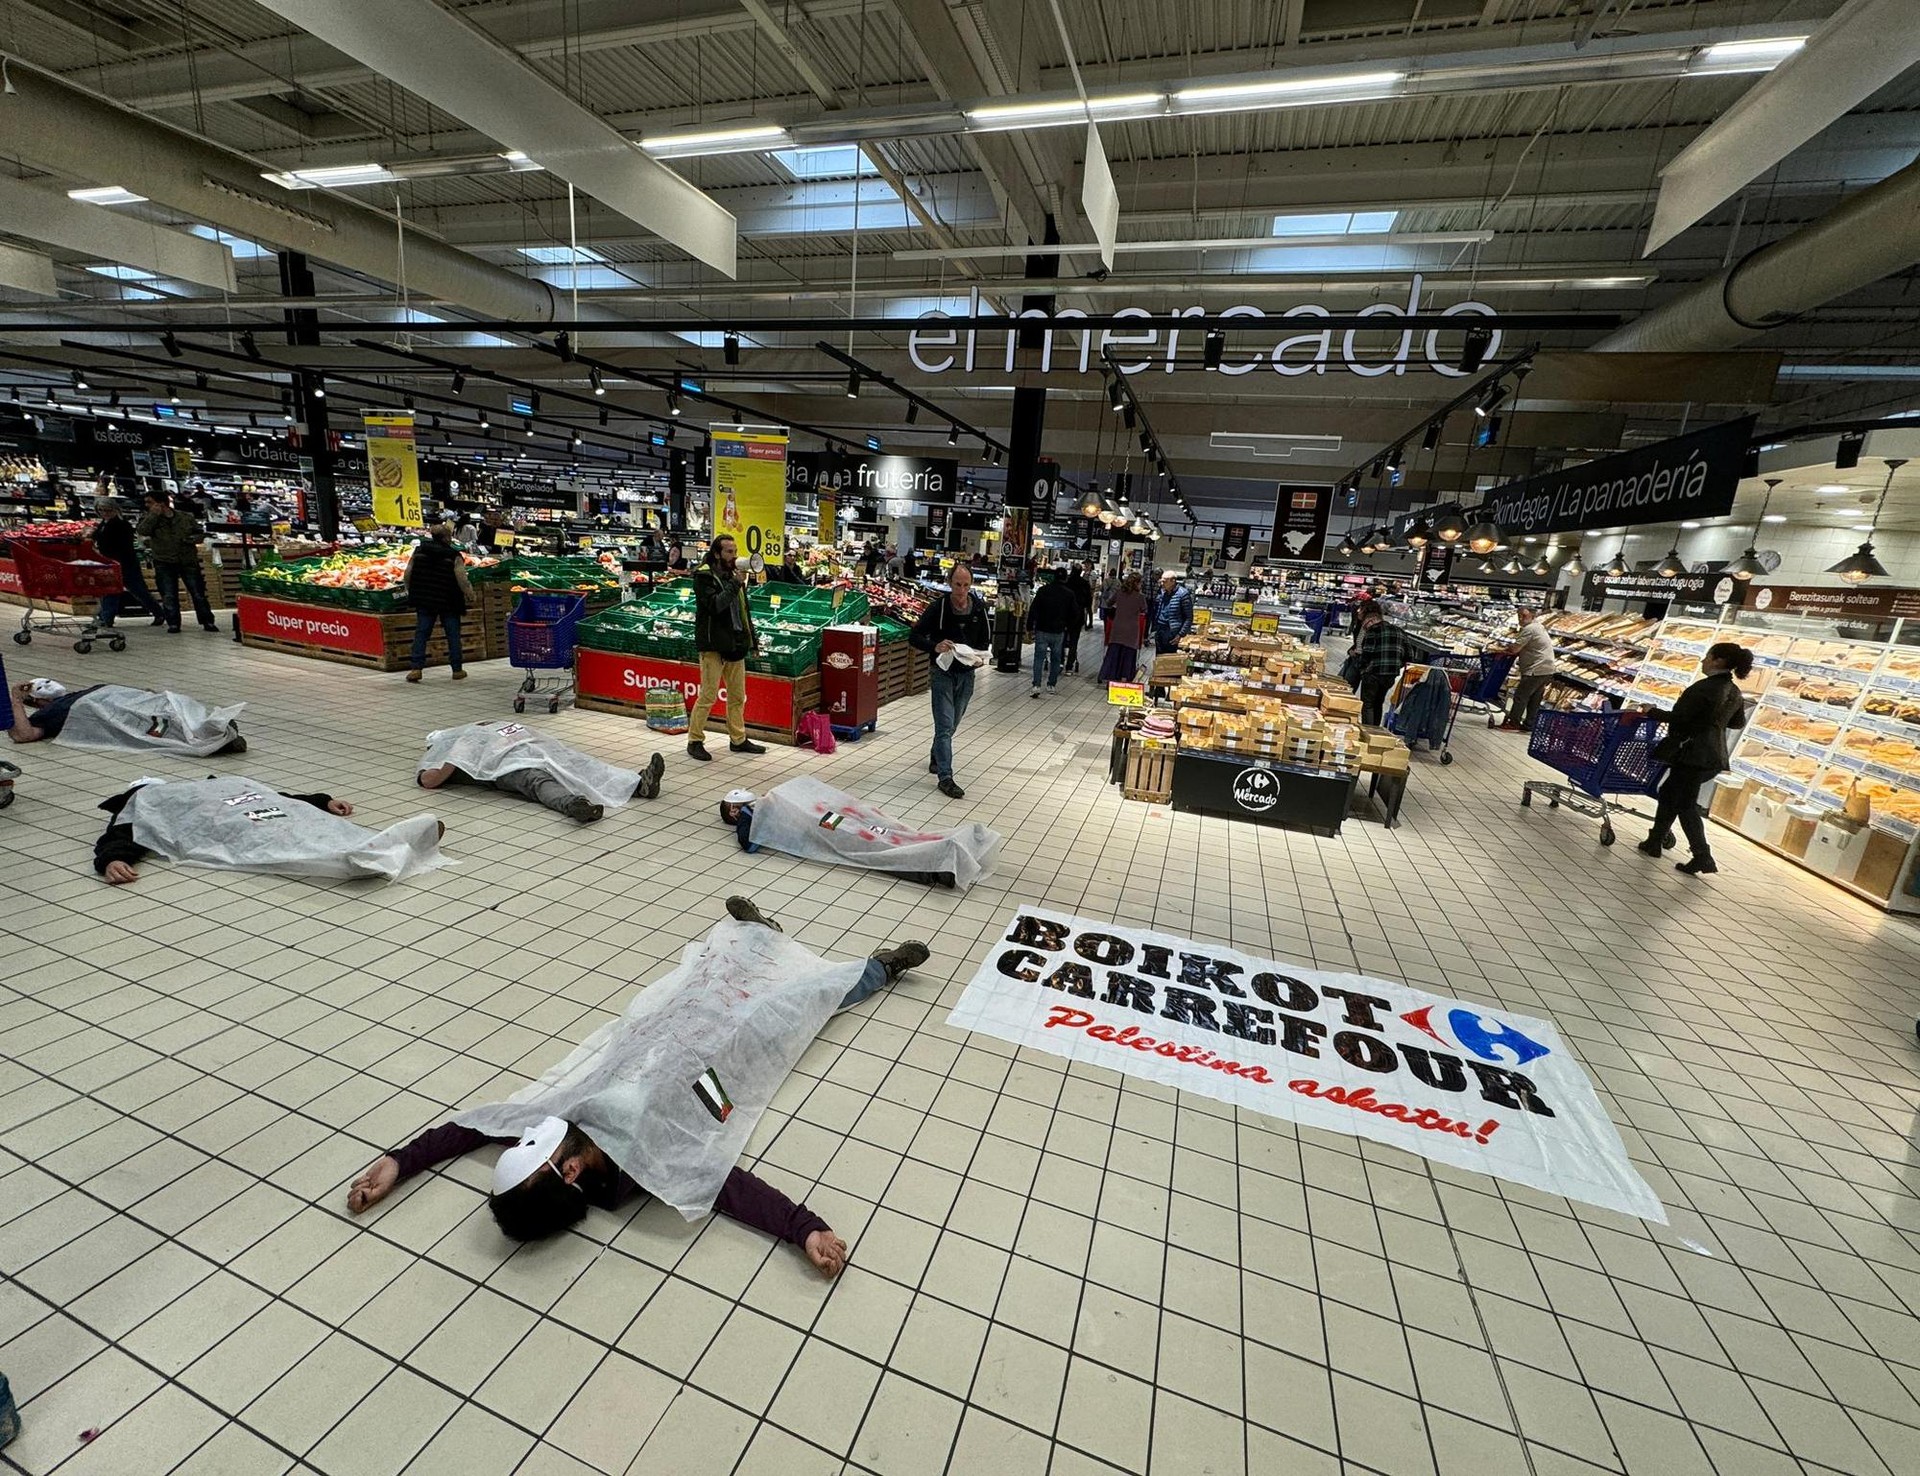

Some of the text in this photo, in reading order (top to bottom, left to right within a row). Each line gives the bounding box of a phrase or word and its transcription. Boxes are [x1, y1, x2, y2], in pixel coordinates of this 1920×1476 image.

[908, 272, 1503, 378] el mercado
[239, 444, 299, 463] Urdaite
[857, 463, 943, 492] frutería
[1558, 482, 1580, 517] La
[1579, 449, 1709, 523] panadería
[1688, 576, 1705, 591] ogia
[1788, 590, 1846, 604] Berezitasunak
[266, 610, 350, 637] Super precio
[623, 668, 681, 692] Super
[1233, 788, 1278, 806] Mercado
[1005, 914, 1392, 1032] BOIKOT
[996, 949, 1556, 1118] CARREFOUR
[1043, 1005, 1501, 1146] Palestina askatu!
